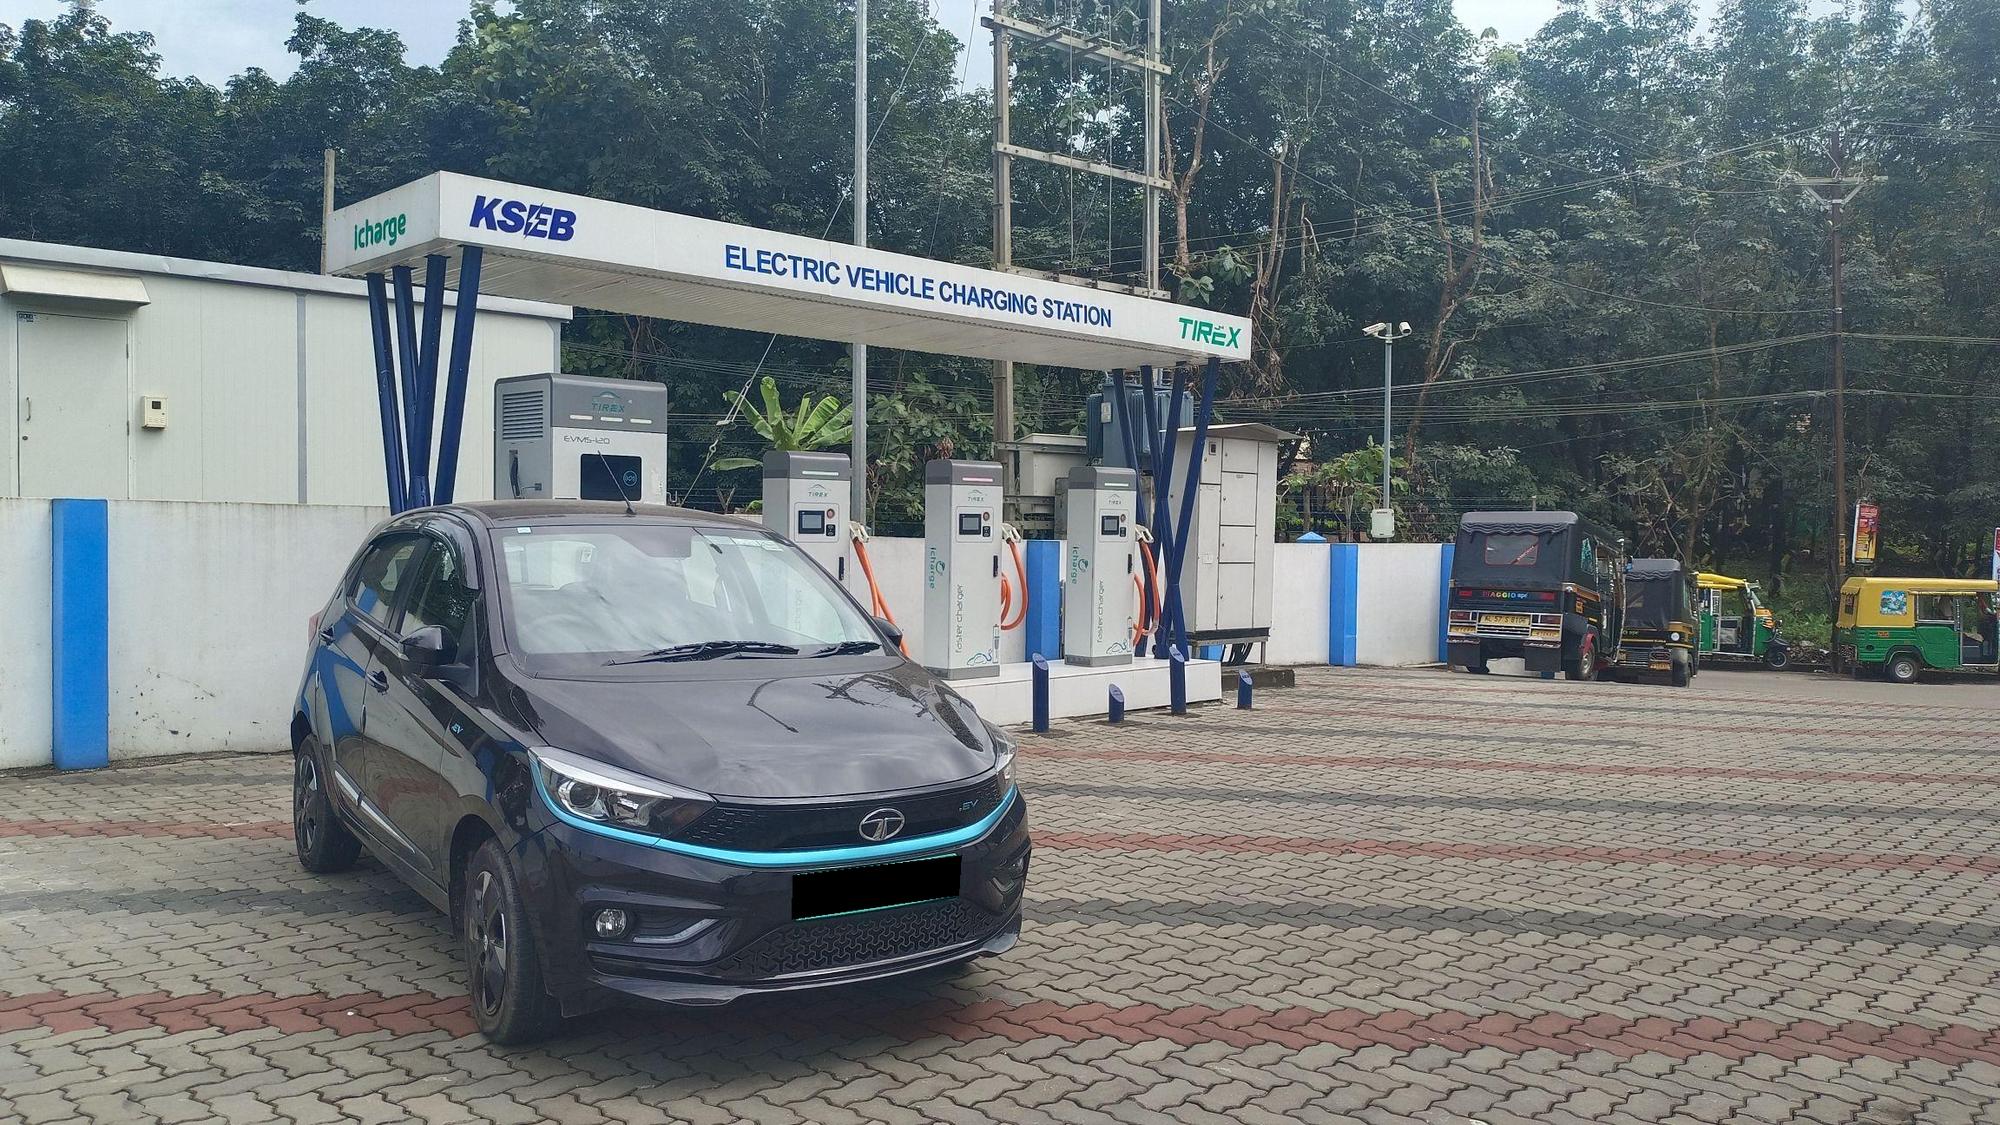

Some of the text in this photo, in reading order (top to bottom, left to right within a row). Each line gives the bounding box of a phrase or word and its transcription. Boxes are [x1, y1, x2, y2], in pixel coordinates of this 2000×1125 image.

[470, 195, 577, 242] KSEB
[725, 244, 1112, 328] ELECTRIC VEHICLE CHARGING STATION
[1178, 317, 1242, 349] TIREX
